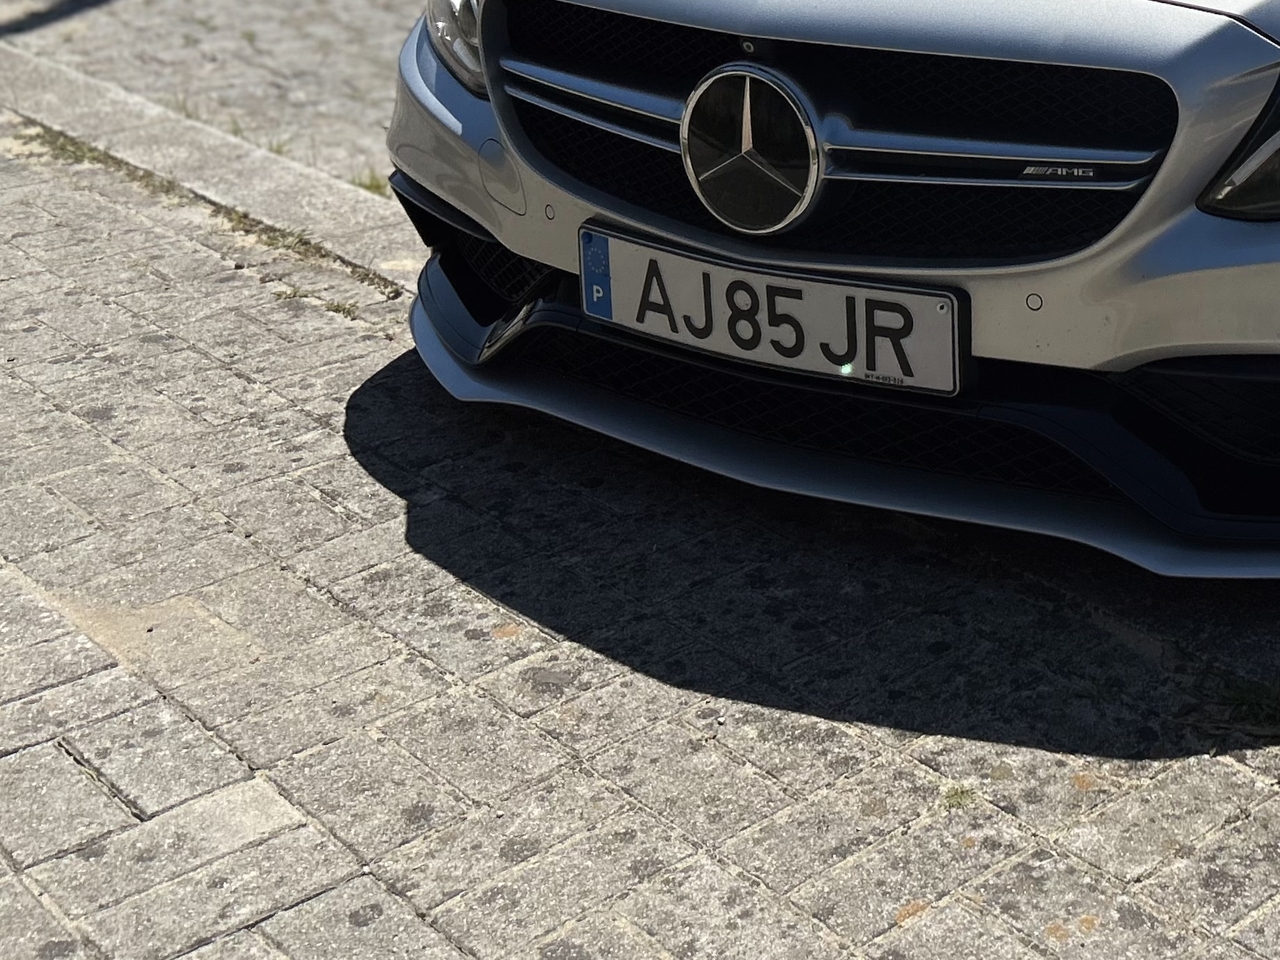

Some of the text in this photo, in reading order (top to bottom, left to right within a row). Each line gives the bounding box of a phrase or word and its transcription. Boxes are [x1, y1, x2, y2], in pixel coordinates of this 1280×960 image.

[1045, 167, 1094, 177] AMG
[593, 284, 605, 303] P
[820, 296, 914, 377] JR
